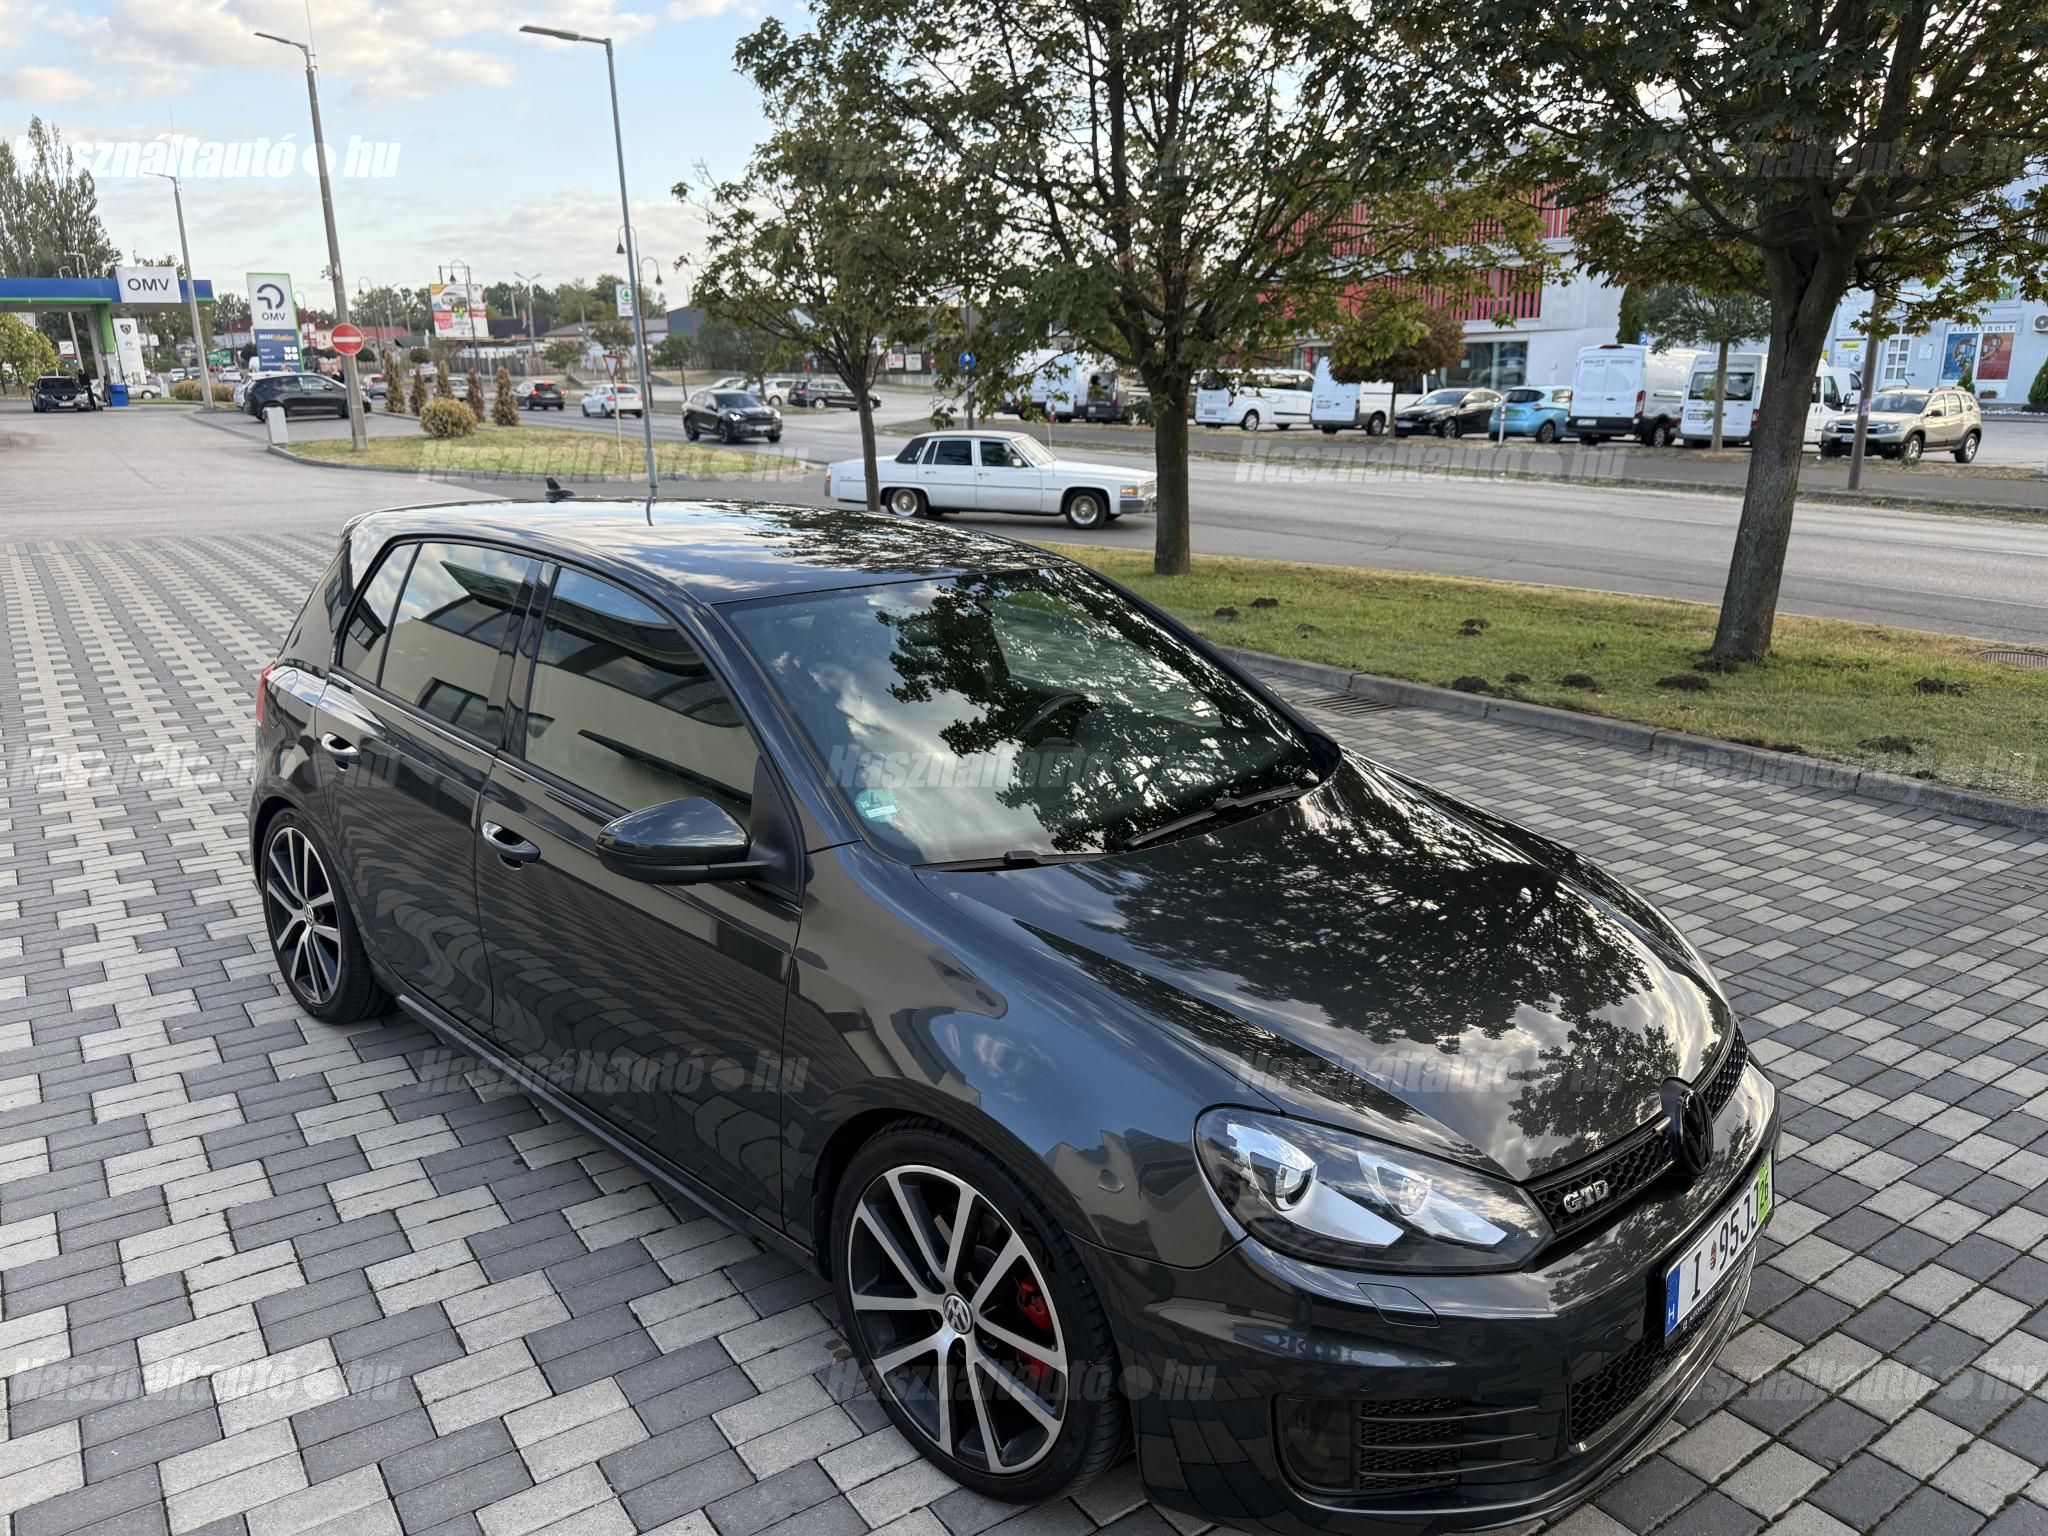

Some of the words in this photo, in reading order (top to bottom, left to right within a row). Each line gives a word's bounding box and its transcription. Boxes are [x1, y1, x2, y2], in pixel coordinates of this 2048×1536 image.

[127, 278, 169, 291] OMV
[261, 312, 286, 321] OMV
[1563, 1180, 1609, 1213] GTD
[1667, 1303, 1675, 1325] H
